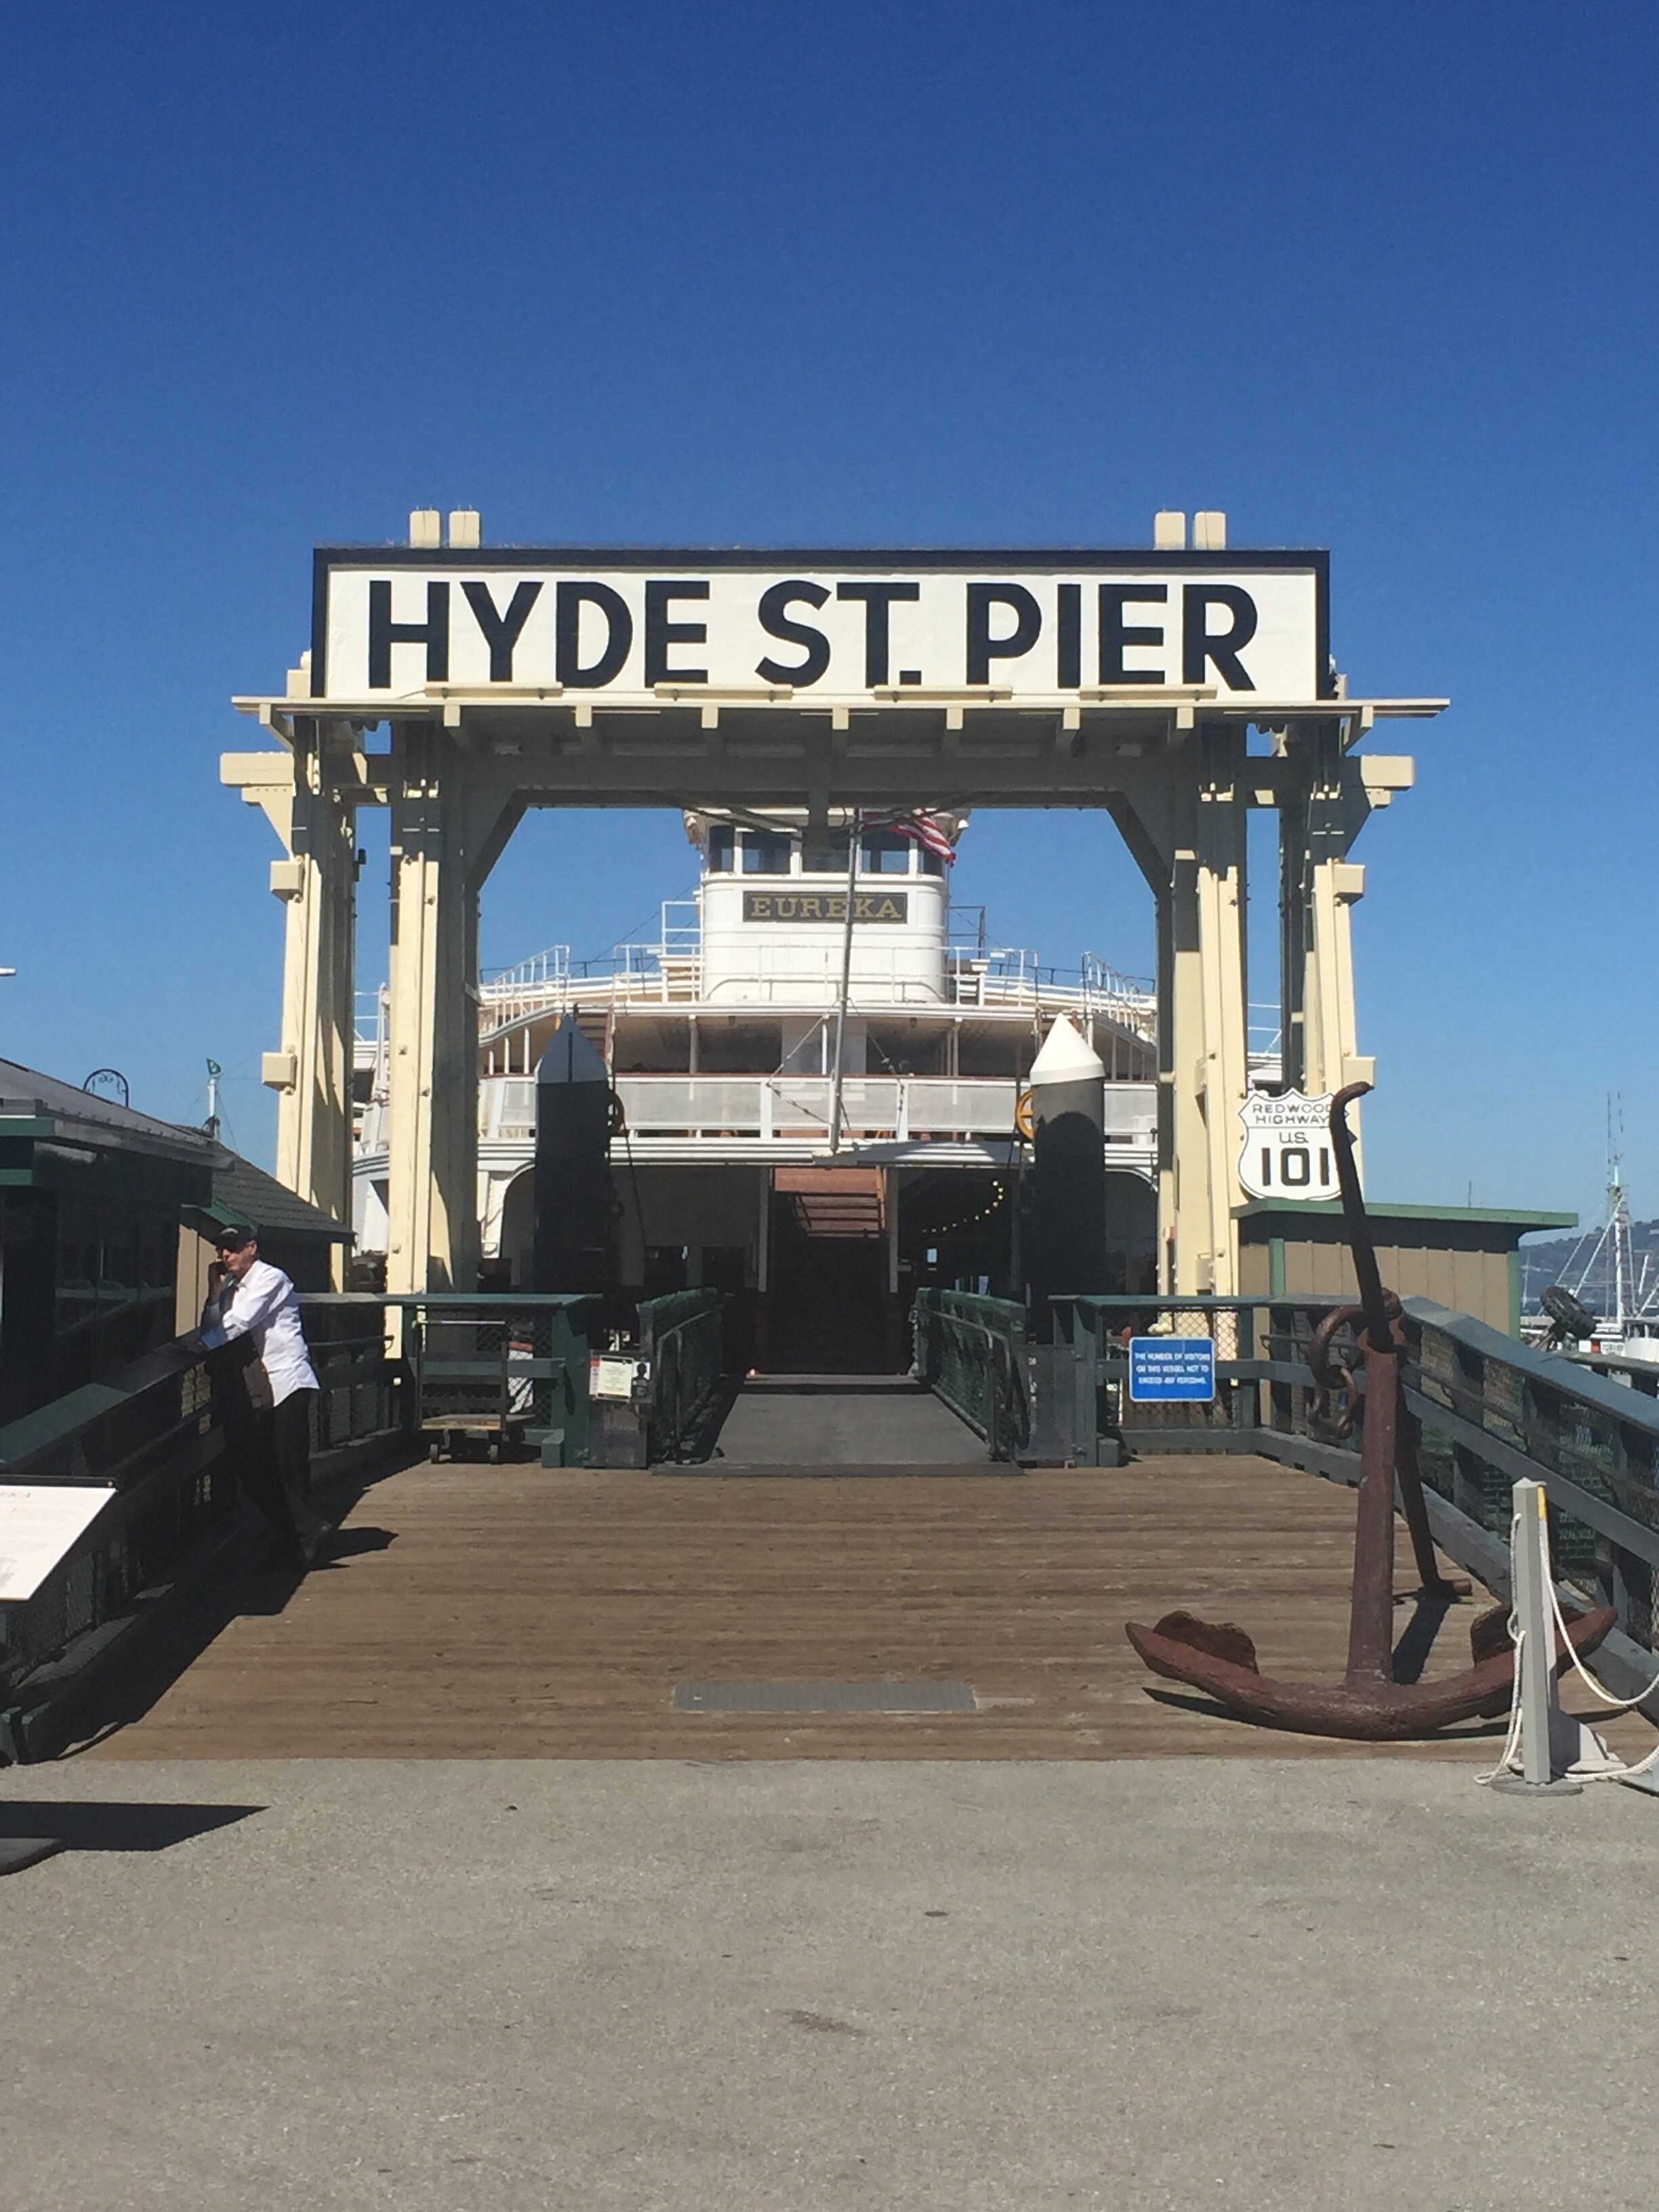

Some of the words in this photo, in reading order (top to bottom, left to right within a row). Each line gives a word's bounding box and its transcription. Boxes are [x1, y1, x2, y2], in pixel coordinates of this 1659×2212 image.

[369, 580, 710, 689] HYDE
[755, 580, 922, 689] ST.
[966, 582, 1258, 691] PIER
[751, 897, 902, 918] EUREKA
[1256, 1115, 1330, 1124] HIGHWAY
[1261, 1147, 1330, 1187] 101
